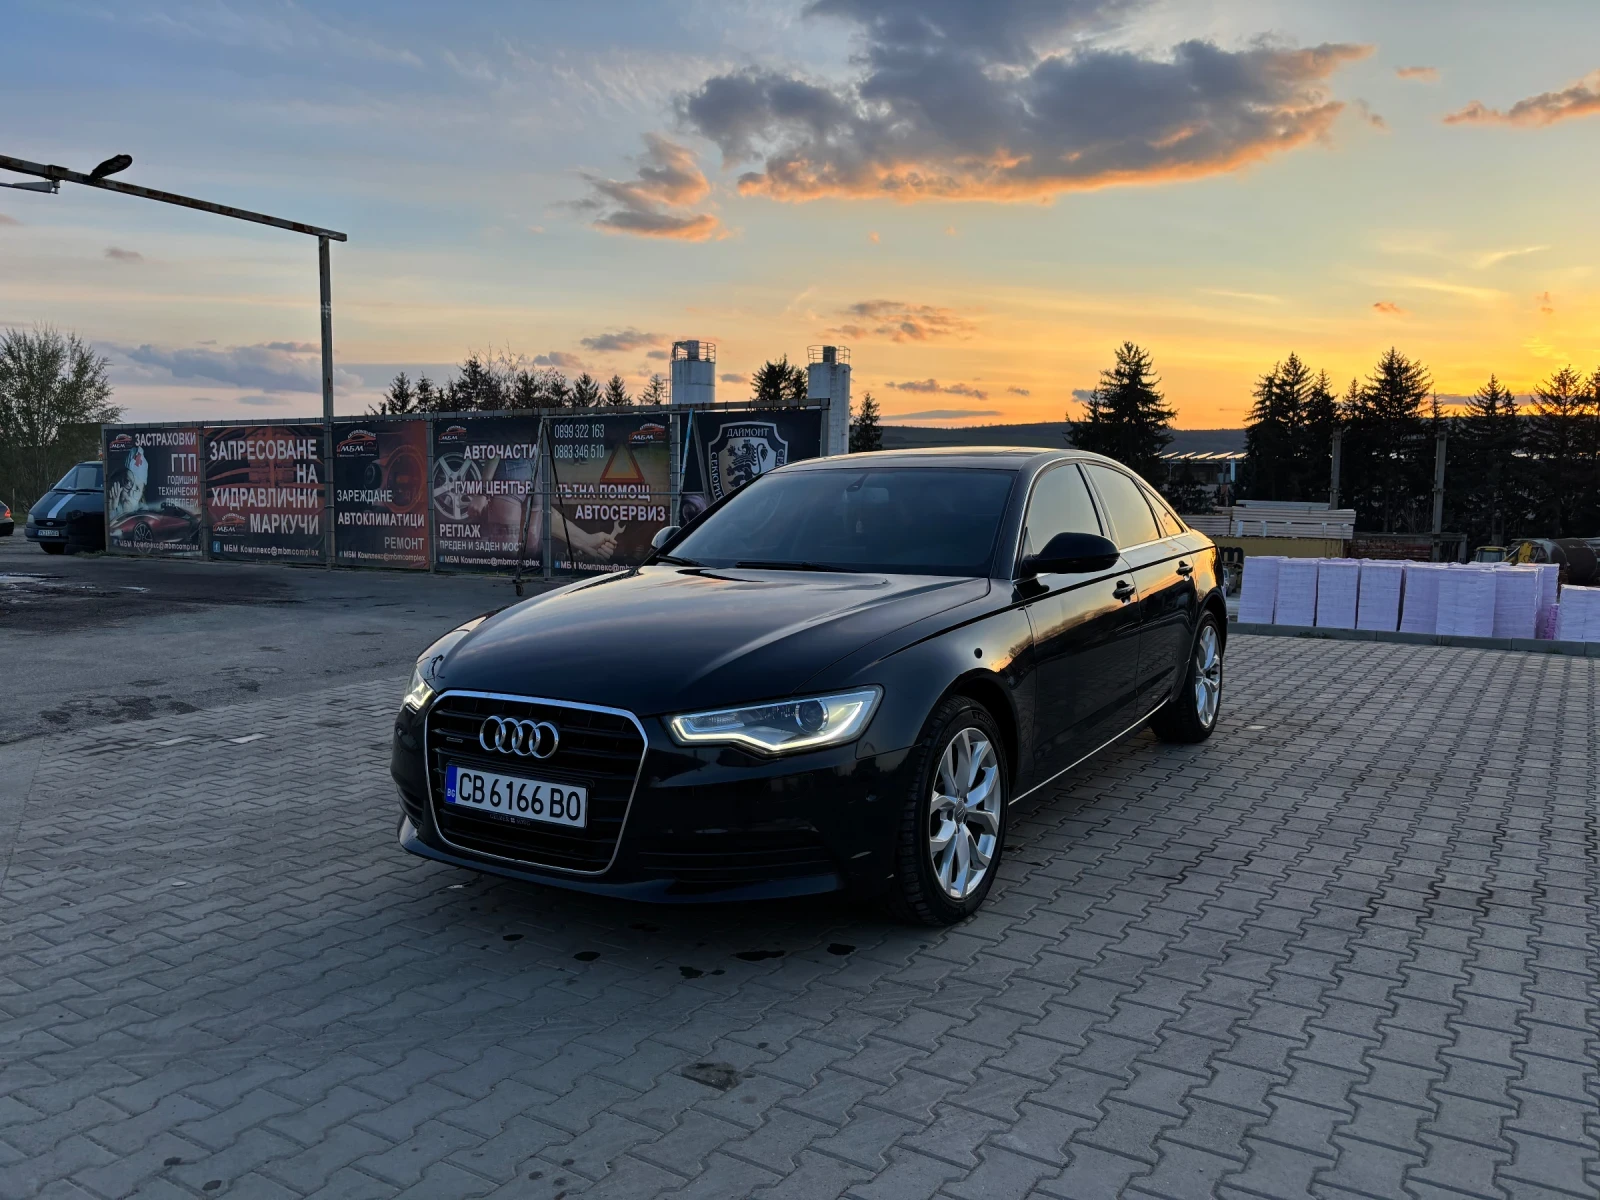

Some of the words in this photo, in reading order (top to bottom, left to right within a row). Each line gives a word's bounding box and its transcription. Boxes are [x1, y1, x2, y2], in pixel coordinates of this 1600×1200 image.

[555, 424, 573, 439] 0899
[574, 424, 589, 438] 322
[592, 424, 605, 438] 163
[134, 432, 197, 447] ЗАСТРАХОВКИ
[209, 439, 318, 461] ЗАПРЕСОВАНЕ
[463, 444, 538, 460] АВТОЧАСТИ
[555, 444, 574, 459] 0883
[574, 444, 589, 458] 346
[590, 444, 605, 458] 510
[171, 453, 197, 473] ГТП
[167, 476, 198, 486] ГОДИШНИ
[296, 463, 319, 484] НА
[158, 486, 198, 496] ТЕХНИЧЕСКИ
[455, 480, 483, 495] ГУМИ
[599, 484, 651, 502] ПОМОЩ
[211, 487, 318, 511] ХИДРАВЛИЧНИ
[336, 489, 393, 504] ЗАРЕЖДАНЕ
[337, 512, 425, 529] АВТОКЛИМАТИЦИ
[575, 504, 666, 522] АВТОСЕРВИЗ
[250, 513, 319, 535] МАРКУЧИ
[439, 523, 481, 538] РЕГЛАЖ
[222, 544, 239, 553] МБМ
[384, 536, 425, 550] РЕМОНТ
[440, 540, 467, 553] ПРЕДЕН
[468, 542, 474, 551] И
[475, 542, 499, 553] ЗАДЕН
[343, 550, 357, 558] МБМ
[444, 555, 459, 564] МБМ
[447, 787, 456, 798] BG
